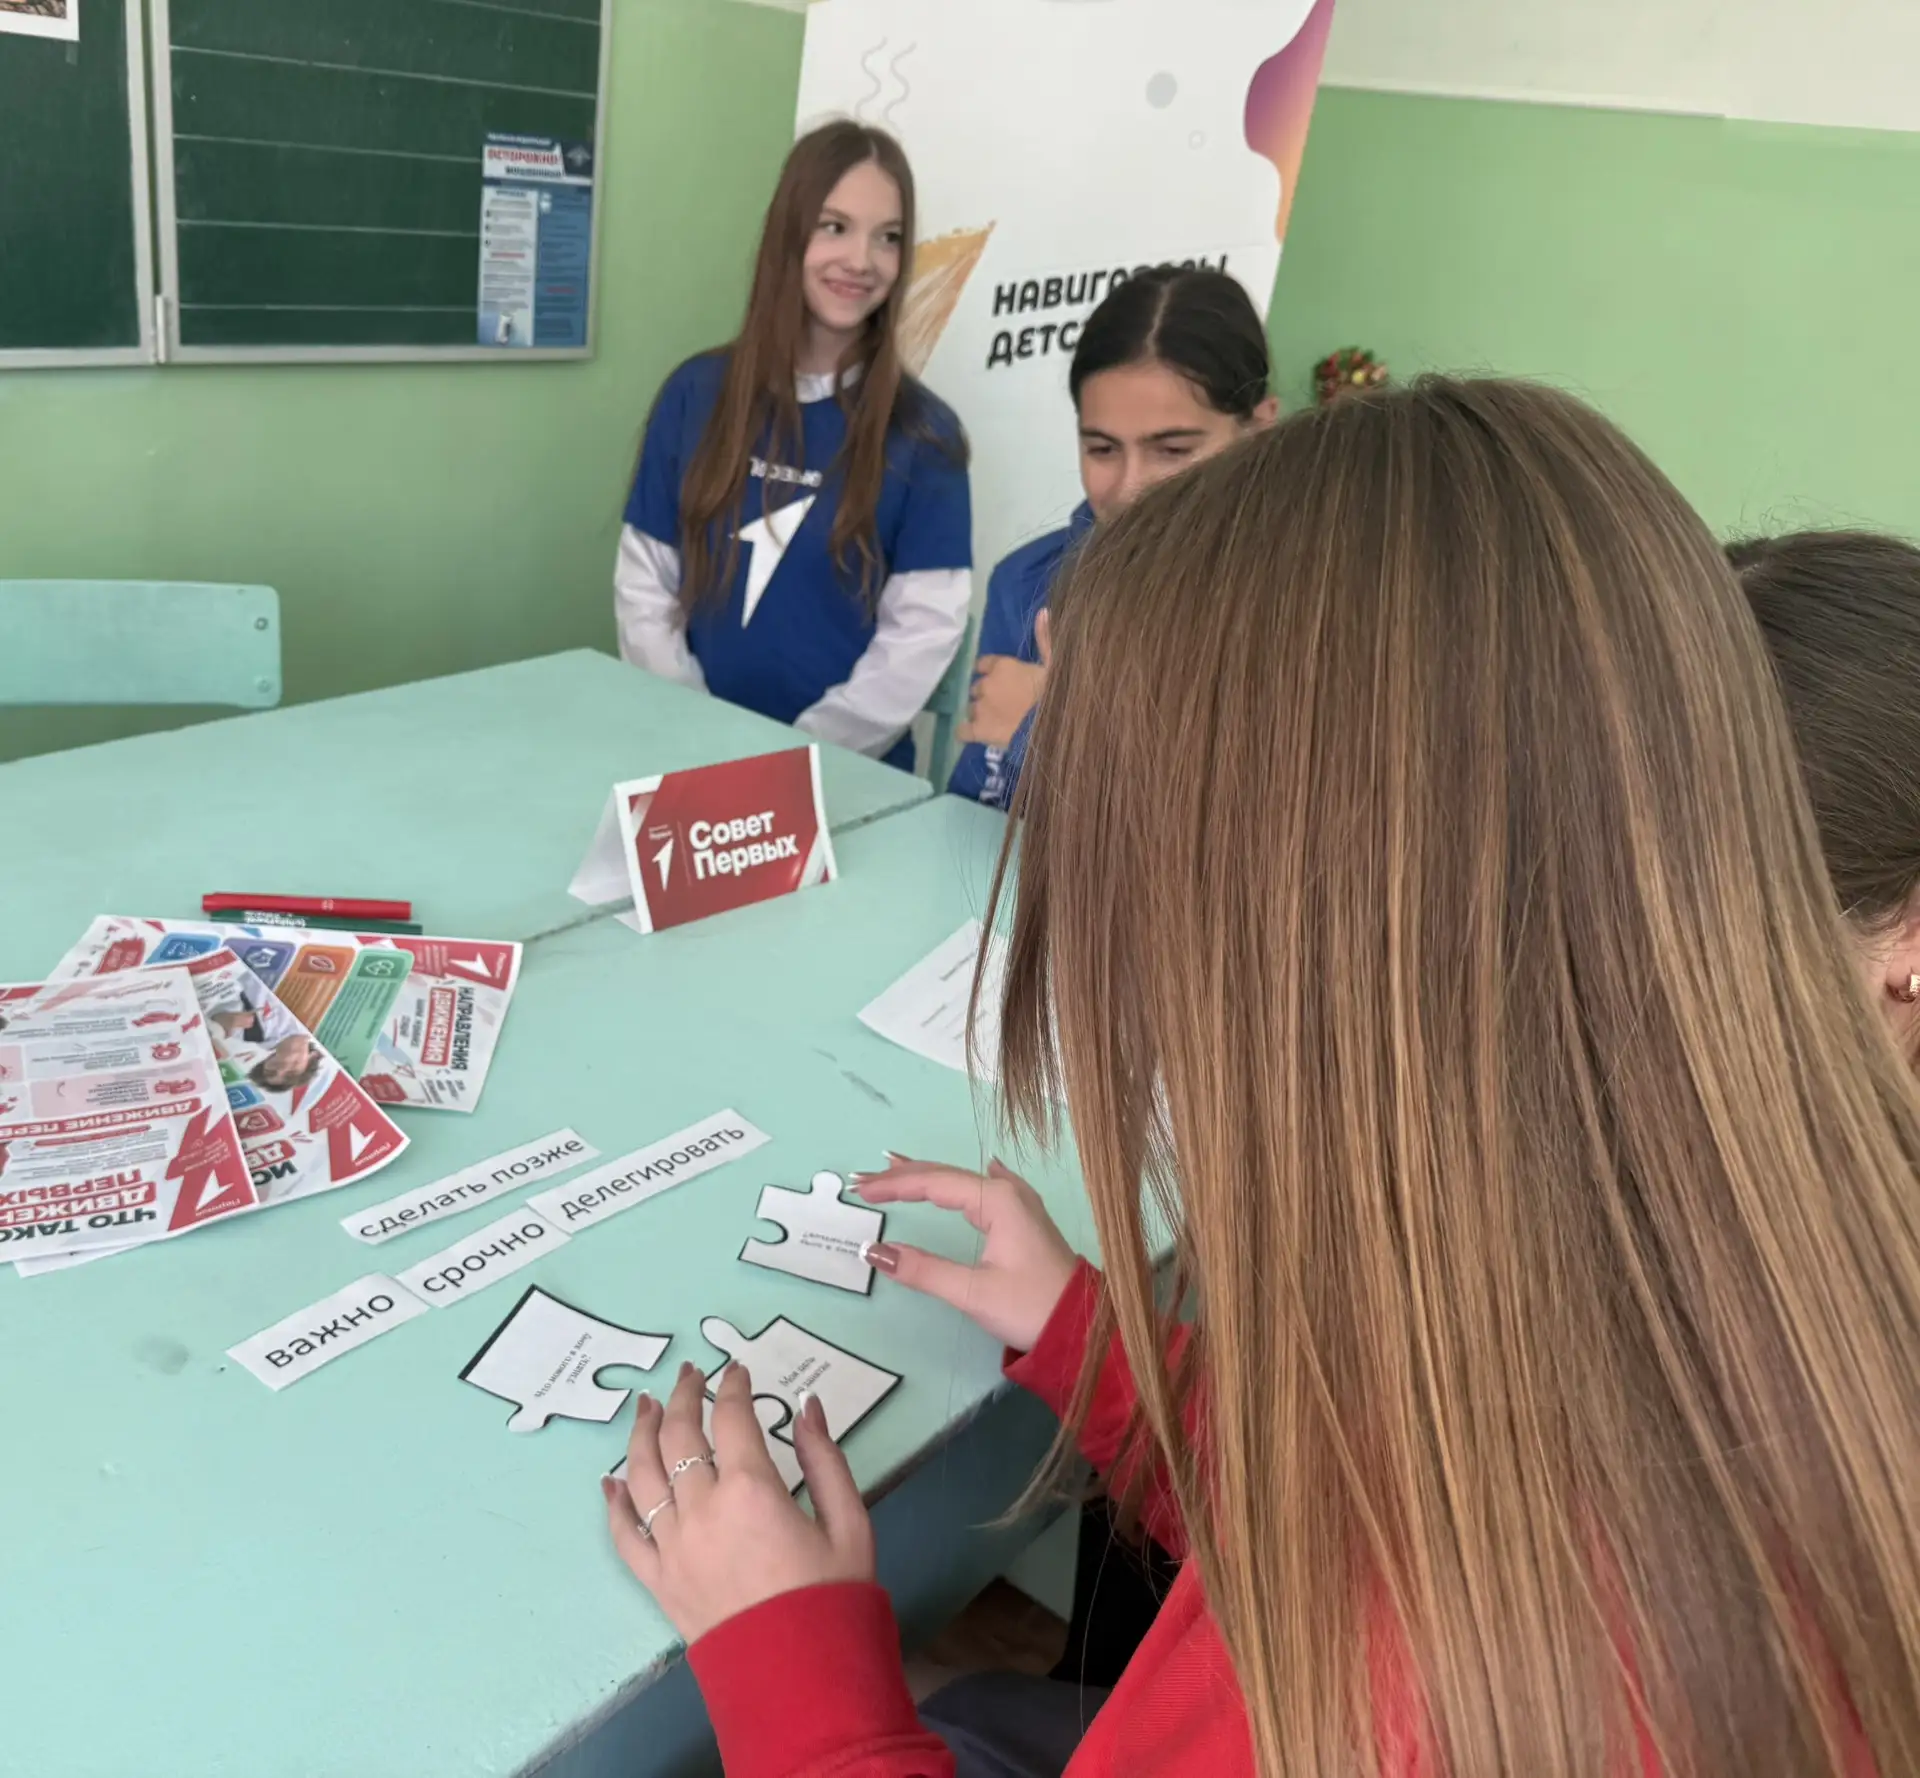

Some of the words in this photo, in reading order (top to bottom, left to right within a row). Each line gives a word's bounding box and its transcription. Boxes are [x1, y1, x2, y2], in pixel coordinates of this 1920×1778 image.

[992, 252, 1228, 316] НАВИГА
[986, 319, 1086, 370] ДЕТС
[689, 810, 775, 850] Совет
[693, 834, 800, 880] Первых
[451, 986, 475, 1071] НАПРАВЛЕНИЯ
[66, 1101, 192, 1132] ДВИЖЕНИЕ
[360, 1179, 488, 1239] сделать
[489, 1136, 585, 1186] позже
[558, 1124, 746, 1221] делегировать
[88, 1207, 157, 1228] ЧТО
[423, 1222, 546, 1289] срочно
[265, 1294, 395, 1369] важно
[534, 1382, 553, 1398] Что
[547, 1354, 573, 1385] нового
